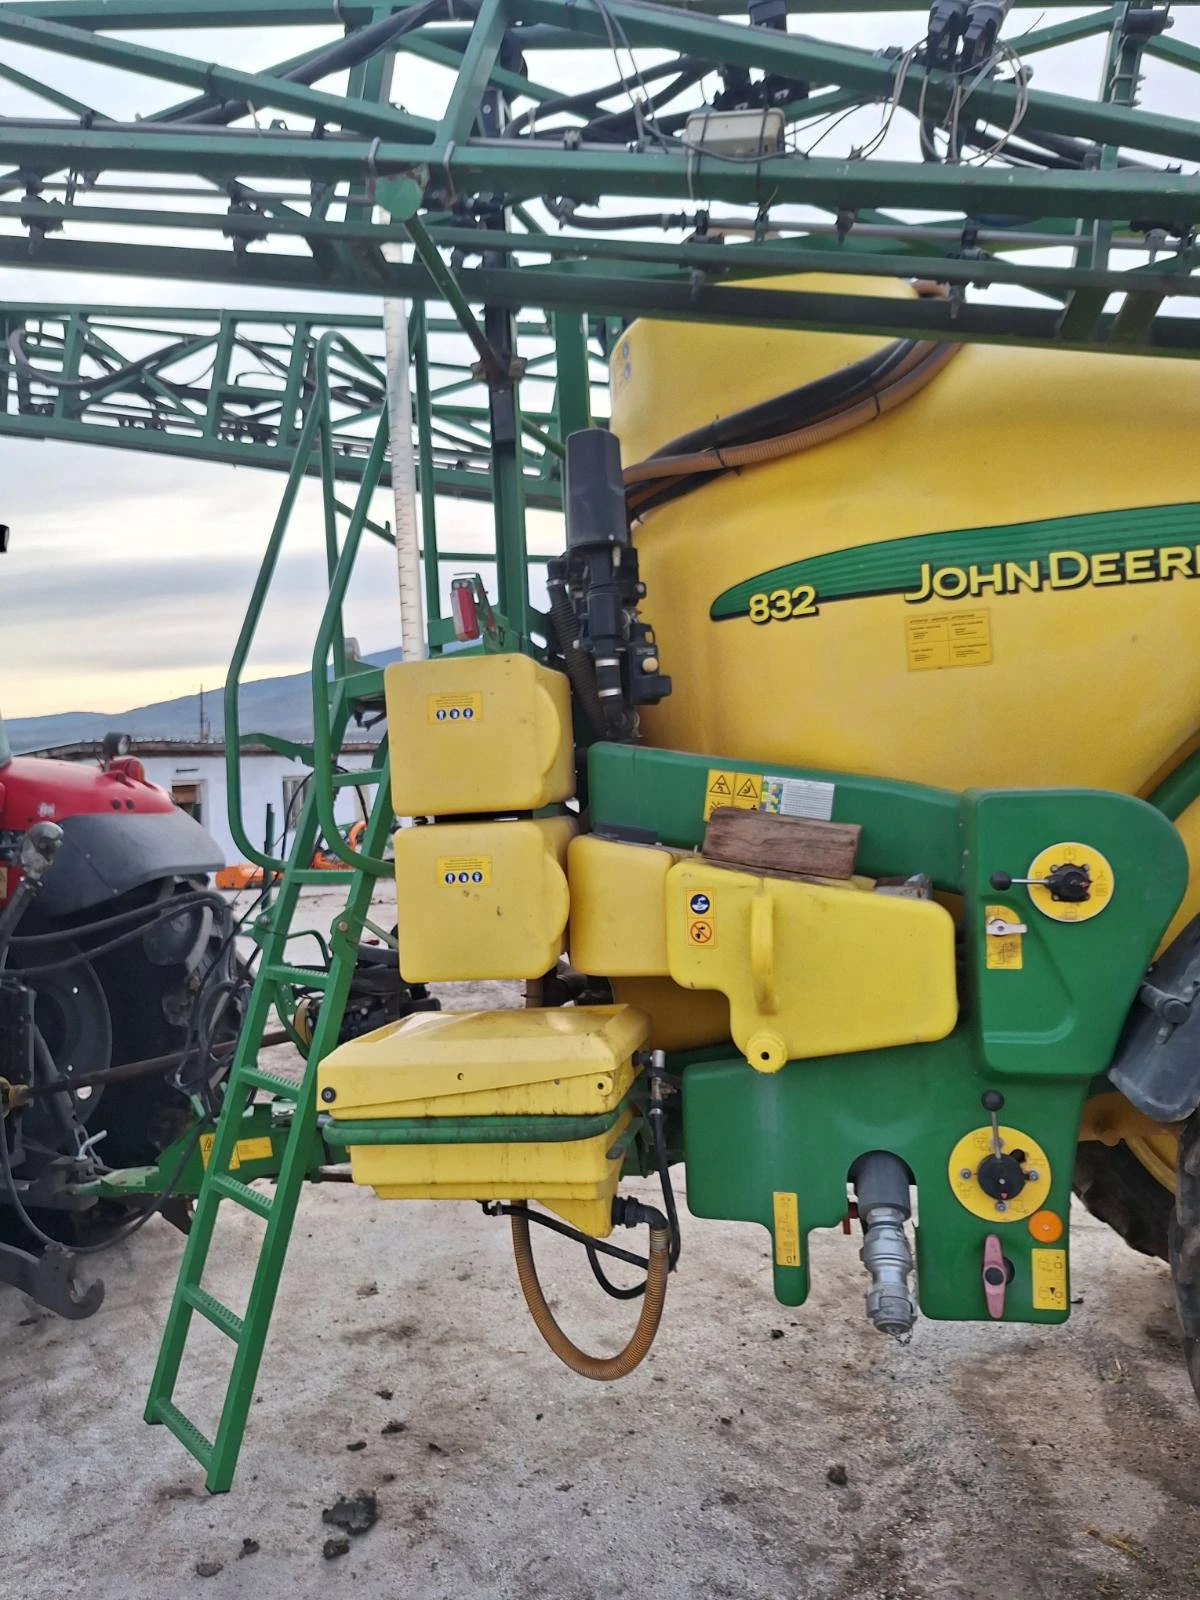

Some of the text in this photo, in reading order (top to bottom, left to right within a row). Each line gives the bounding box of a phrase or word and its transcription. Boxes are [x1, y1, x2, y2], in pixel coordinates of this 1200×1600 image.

[904, 544, 1200, 601] JOHN DEER
[749, 585, 817, 623] 832
